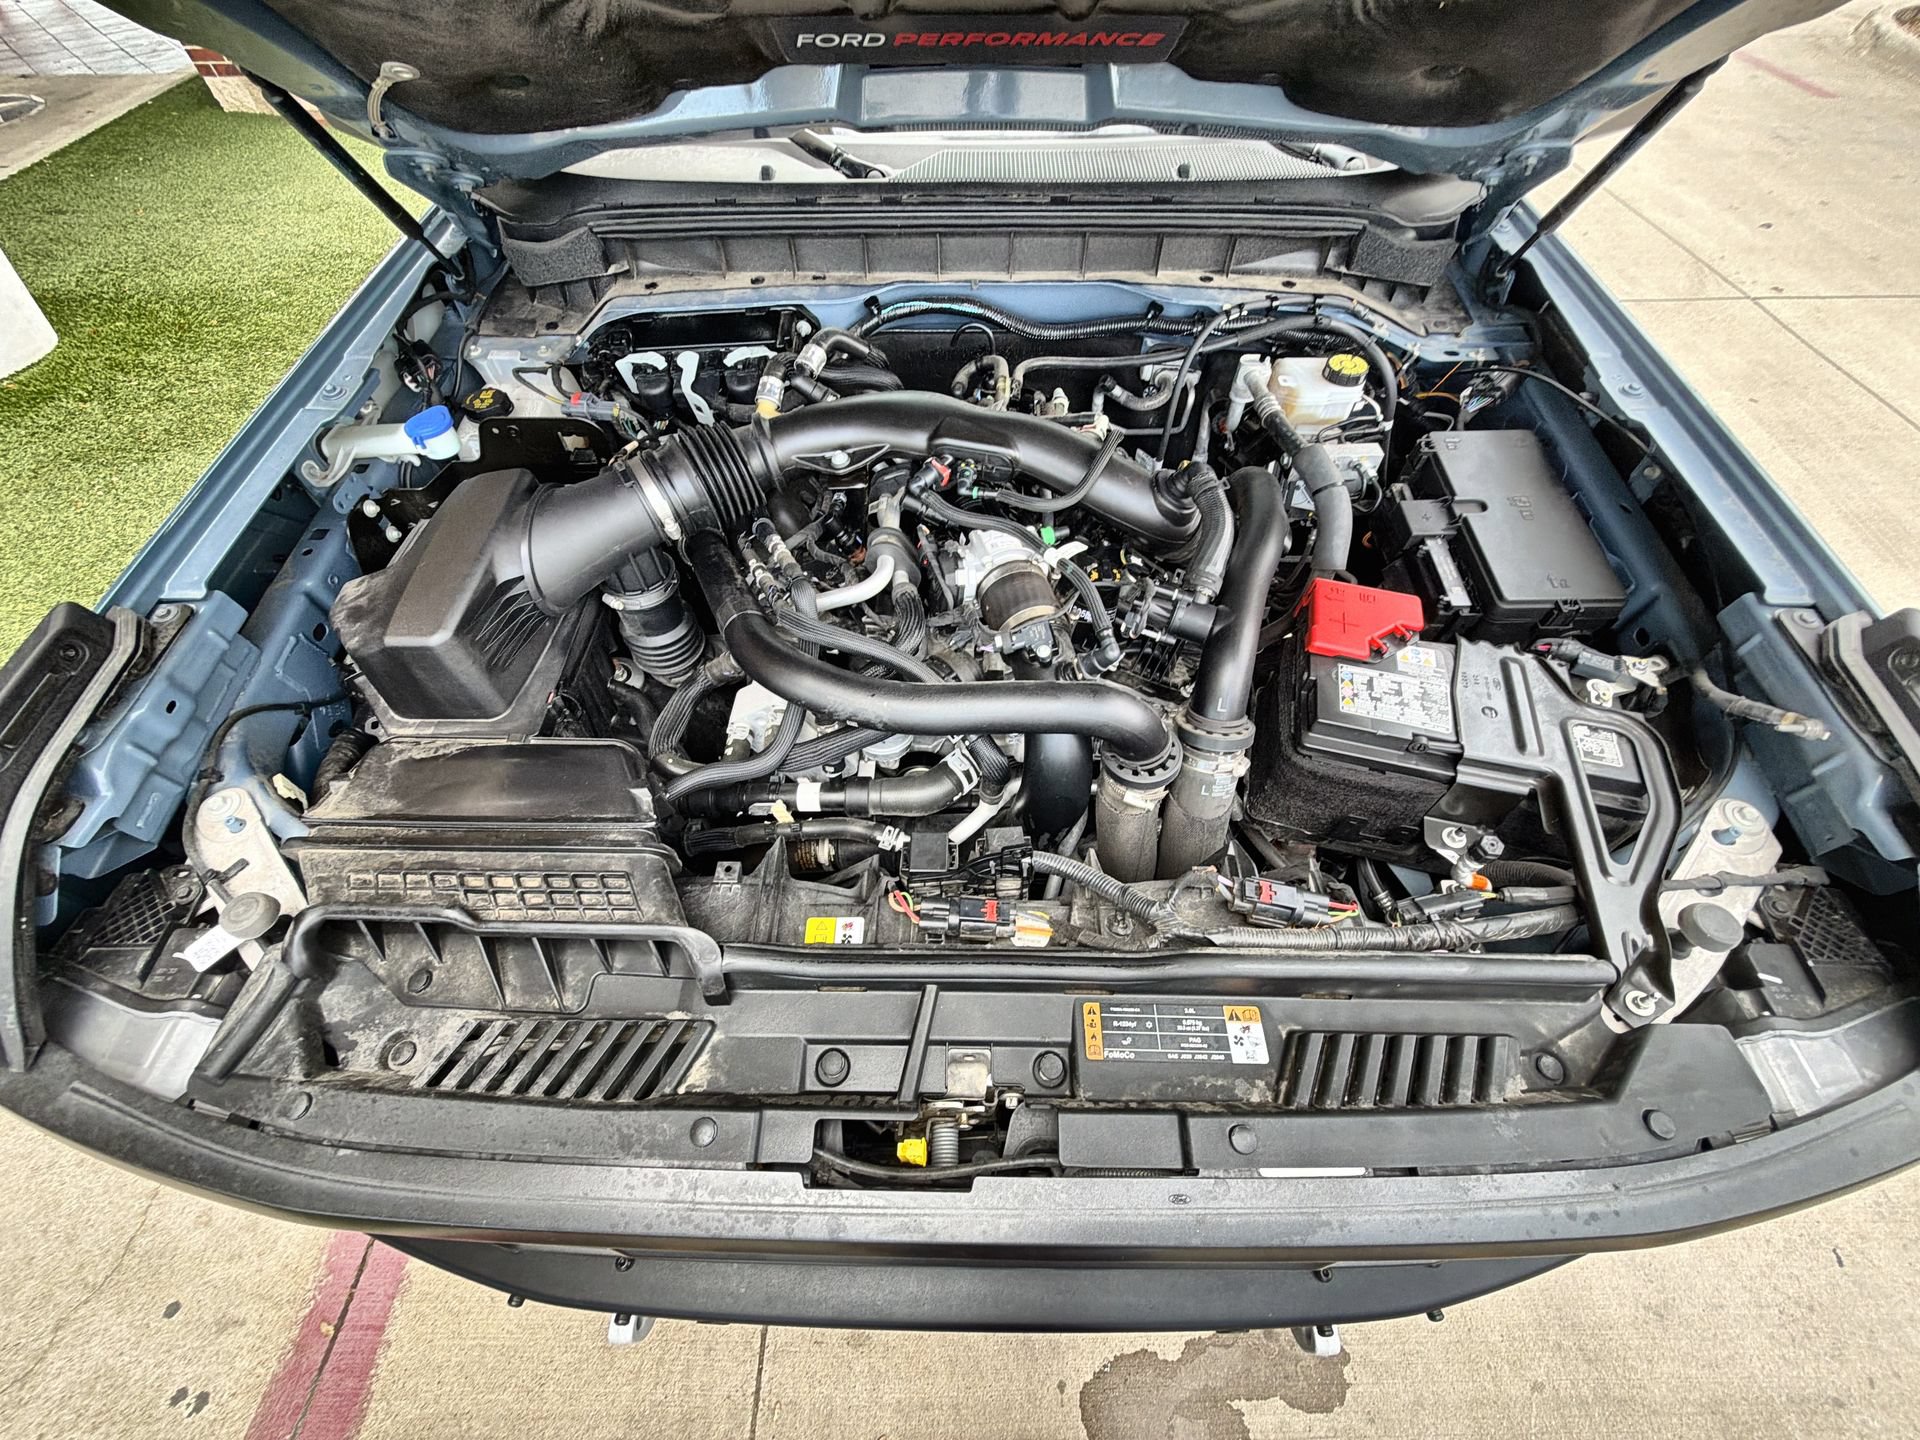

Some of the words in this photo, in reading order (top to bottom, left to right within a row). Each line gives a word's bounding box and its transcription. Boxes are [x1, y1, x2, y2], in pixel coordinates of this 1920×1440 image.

[796, 33, 886, 48] FORD
[893, 32, 1166, 47] PERFORMANCE
[1217, 697, 1227, 712] L
[1104, 1051, 1135, 1059] FoMoCo
